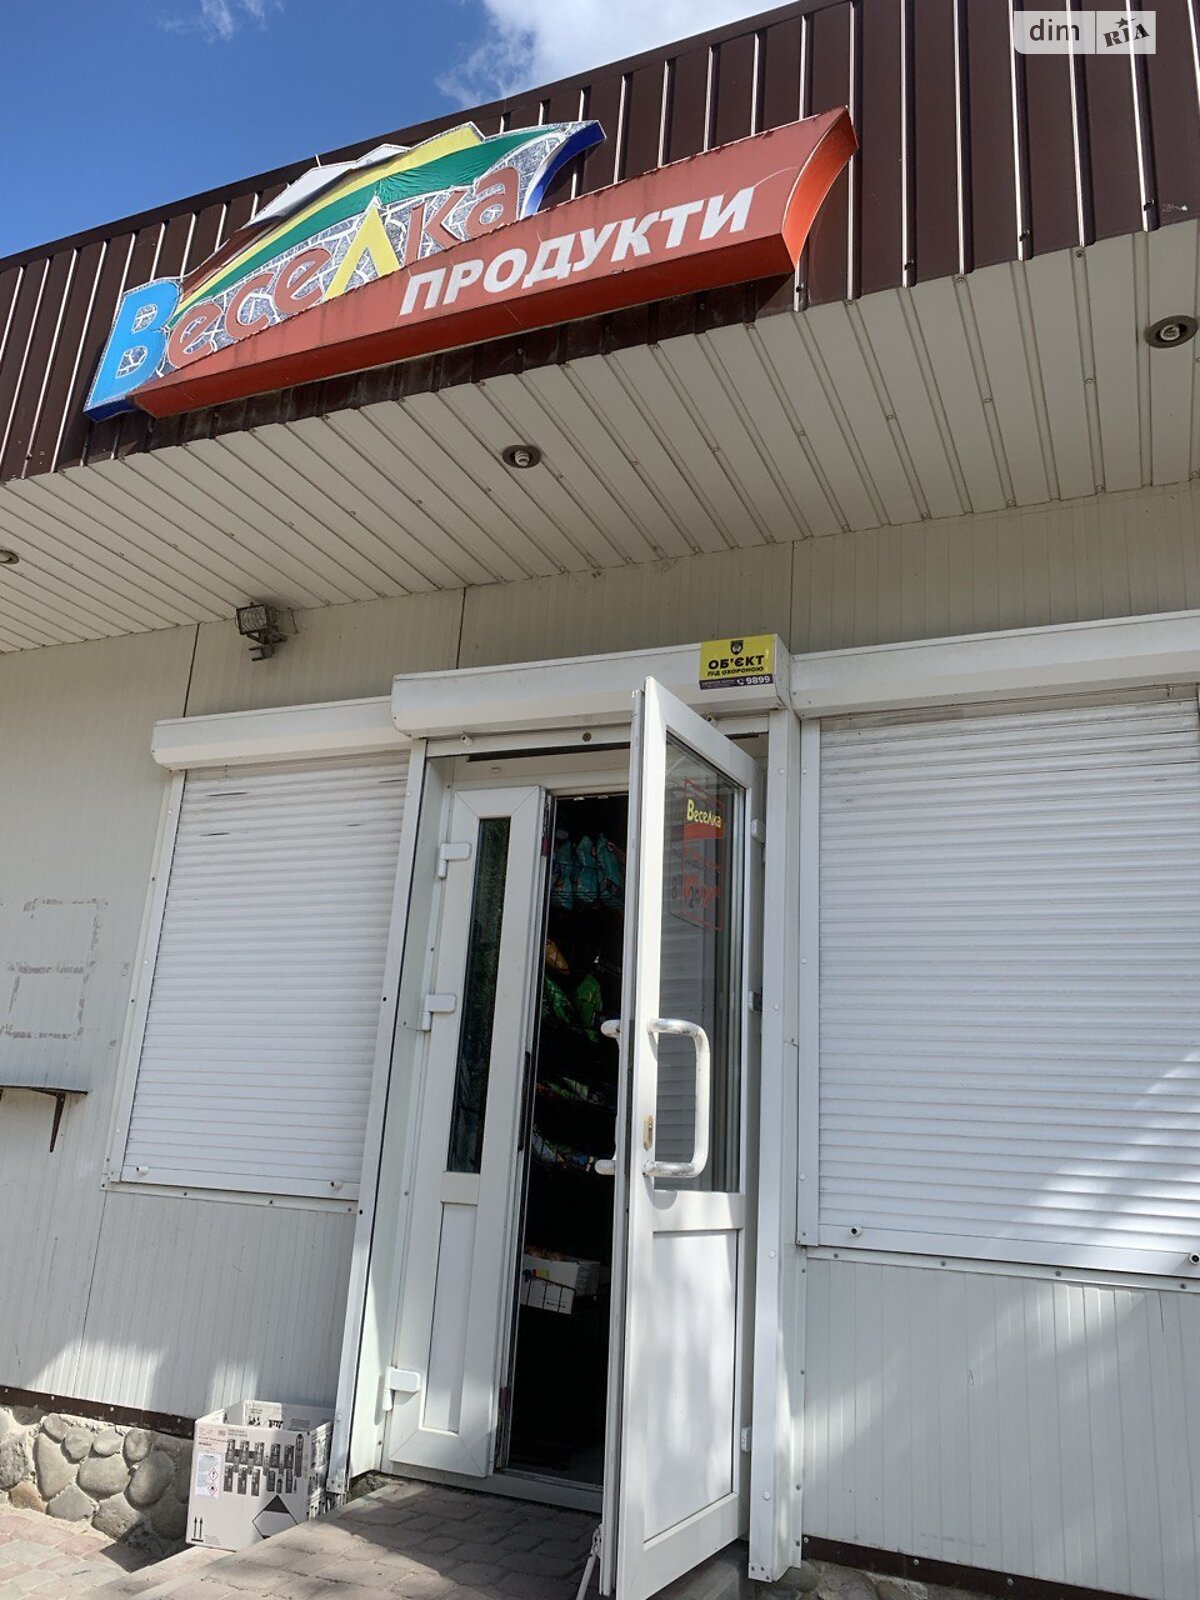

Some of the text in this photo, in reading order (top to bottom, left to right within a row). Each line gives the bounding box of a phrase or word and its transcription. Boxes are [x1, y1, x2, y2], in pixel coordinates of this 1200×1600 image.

[398, 186, 756, 317] ПРОДУКТИ
[708, 655, 764, 670] ОБ'ЄКТ
[745, 675, 771, 685] 9899
